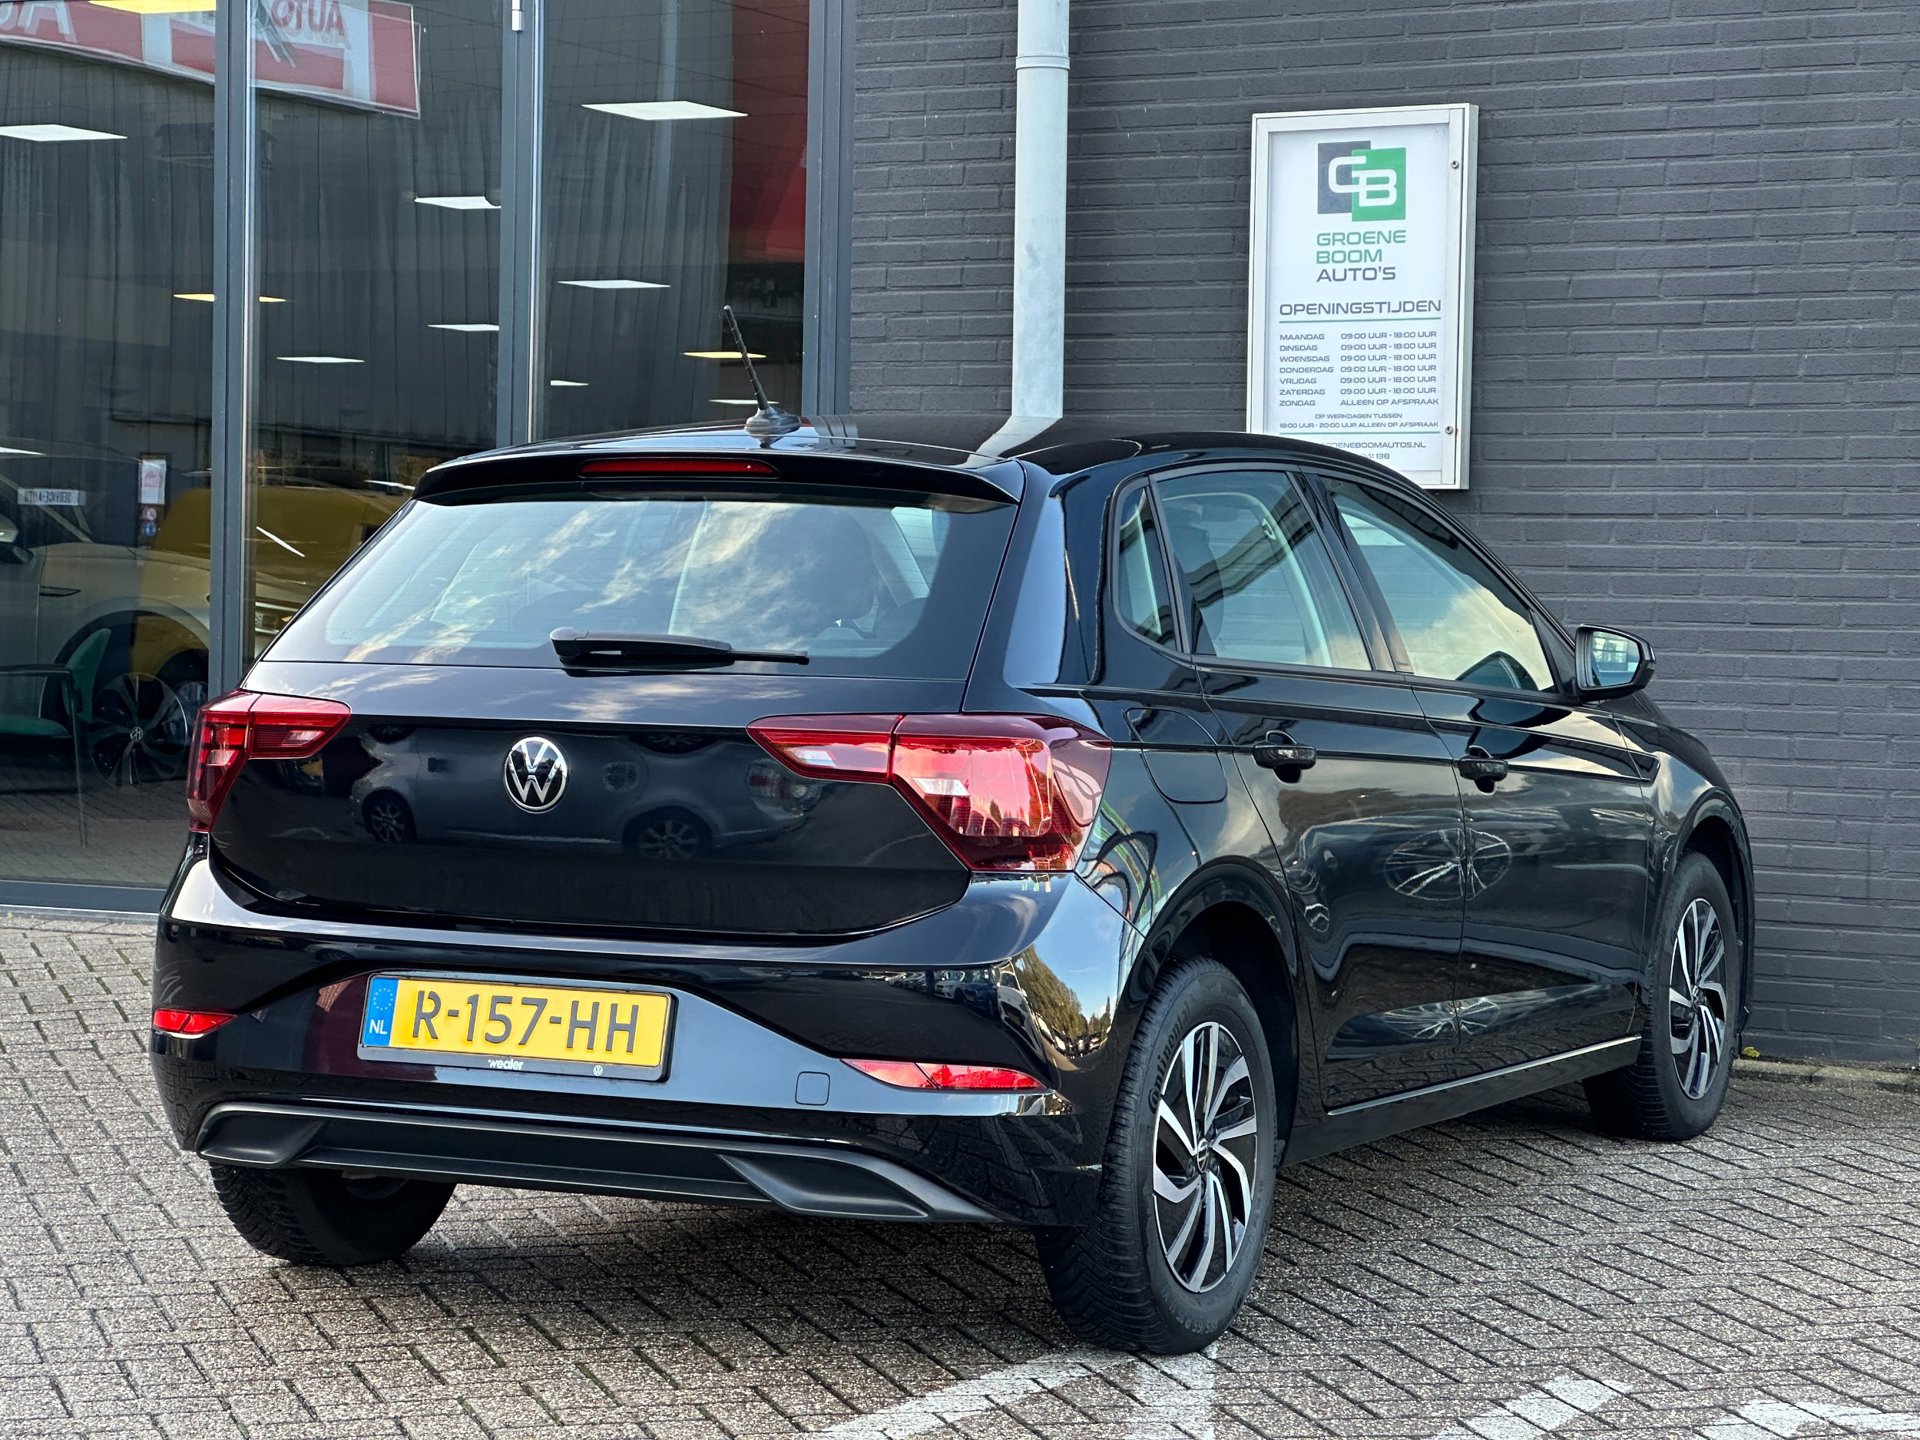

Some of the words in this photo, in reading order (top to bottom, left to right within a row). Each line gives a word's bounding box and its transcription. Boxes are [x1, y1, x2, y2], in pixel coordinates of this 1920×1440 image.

[1317, 230, 1406, 247] GROENE
[1316, 249, 1382, 265] BOOM
[1316, 266, 1396, 282] AUTO'S
[1279, 300, 1442, 316] OPENINGSTIJDEN
[369, 1019, 388, 1035] NL
[412, 989, 640, 1053] R-157-HH
